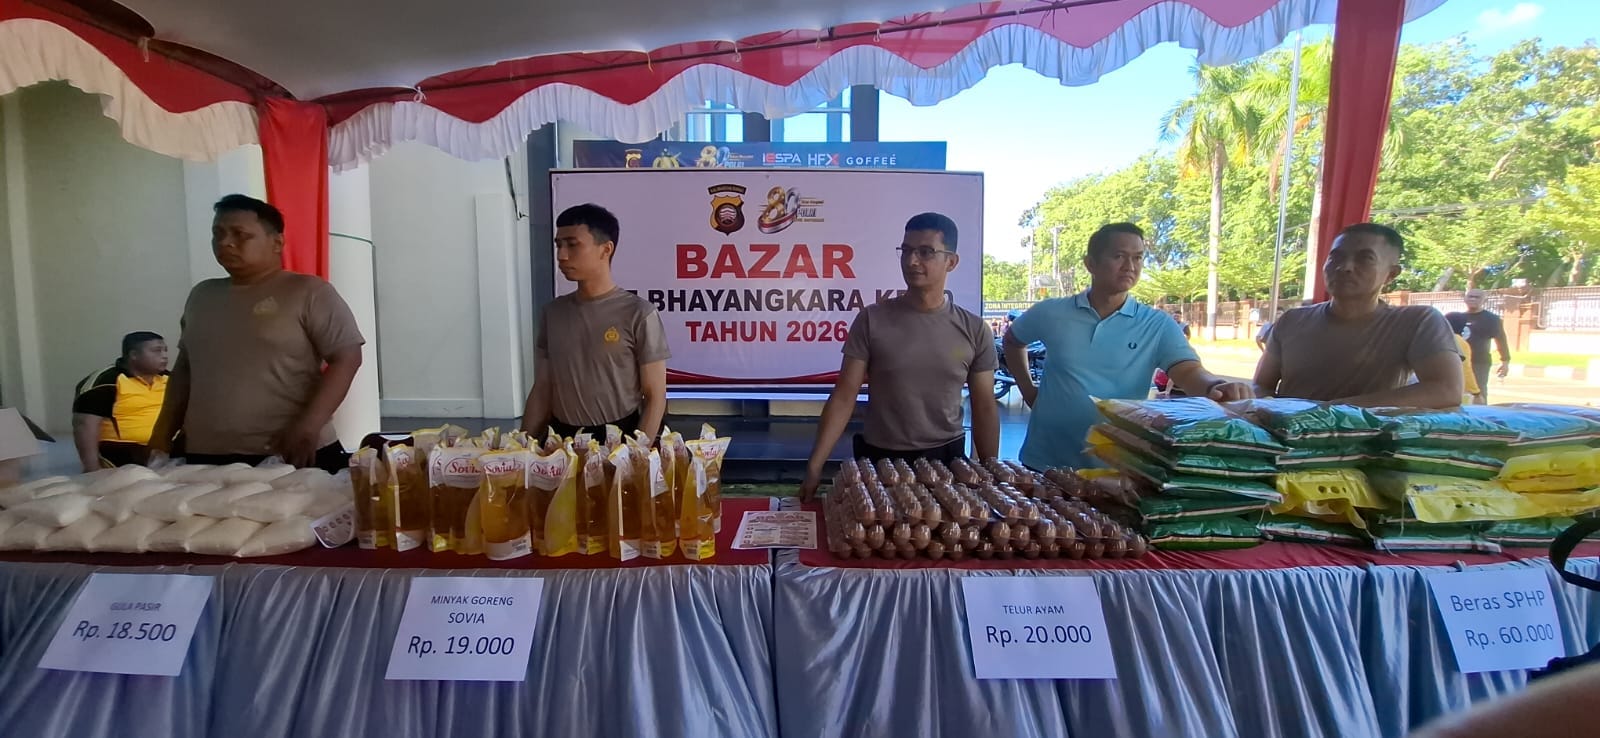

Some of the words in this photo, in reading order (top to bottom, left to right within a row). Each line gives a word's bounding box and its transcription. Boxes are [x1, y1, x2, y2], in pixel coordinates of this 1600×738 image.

[808, 153, 839, 166] HFX
[676, 244, 856, 279] BAZAR
[648, 289, 864, 312] BHAYANGKARA
[685, 321, 778, 342] TAHUN
[786, 321, 848, 342] 2026
[110, 602, 133, 611] GULA
[134, 602, 162, 611] PASIR
[431, 595, 469, 605] MINYAK
[471, 596, 514, 606] GORENG
[1002, 605, 1033, 614] TELUR
[1035, 605, 1065, 614] AYAM
[1450, 595, 1500, 612] Beras
[1503, 590, 1546, 609] SPHP
[447, 612, 486, 624] SOVIA
[72, 620, 101, 641] Rp.
[106, 622, 178, 642] 18.500
[986, 625, 1018, 647] Rp.
[1023, 625, 1092, 643] 20.000
[1465, 629, 1495, 650] Rp.
[1499, 623, 1554, 645] 60.000
[407, 635, 437, 658] Rp.
[444, 636, 515, 655] 19.000
